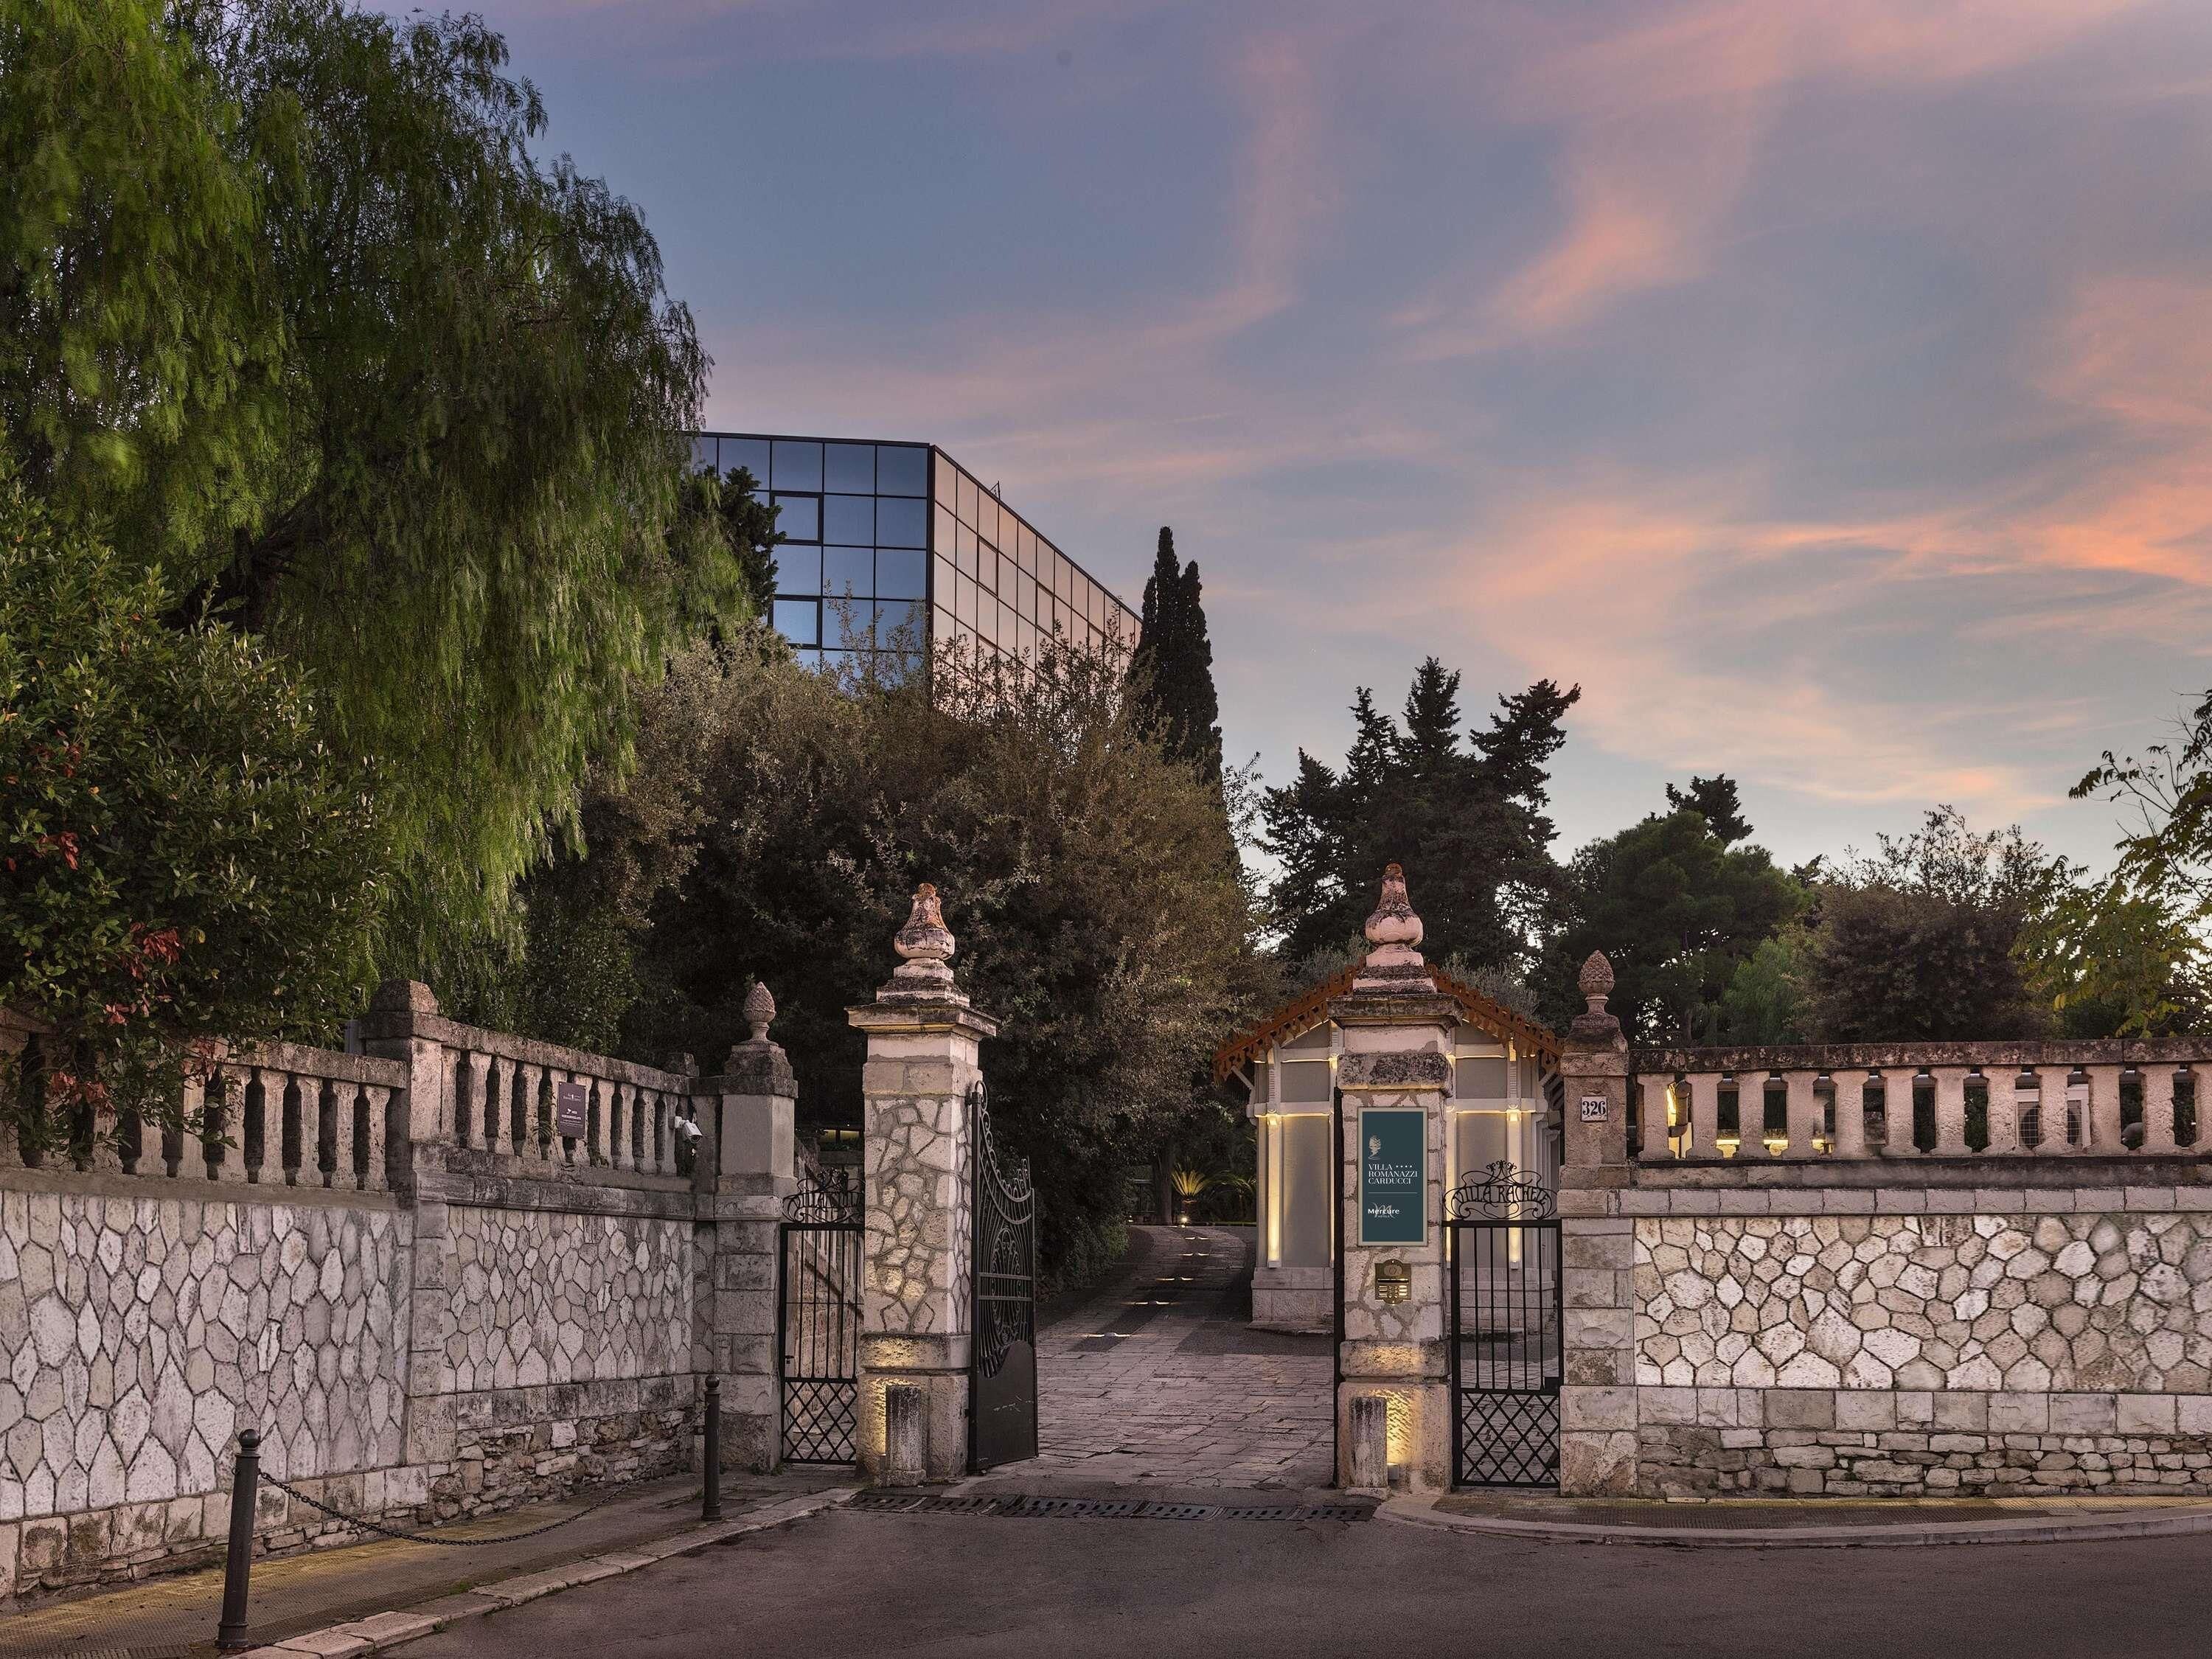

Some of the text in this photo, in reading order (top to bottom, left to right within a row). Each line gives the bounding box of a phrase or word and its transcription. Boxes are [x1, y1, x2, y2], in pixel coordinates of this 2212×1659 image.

[1582, 1101, 1606, 1116] 326
[1453, 1185, 1548, 1204] VILLA RACHELE
